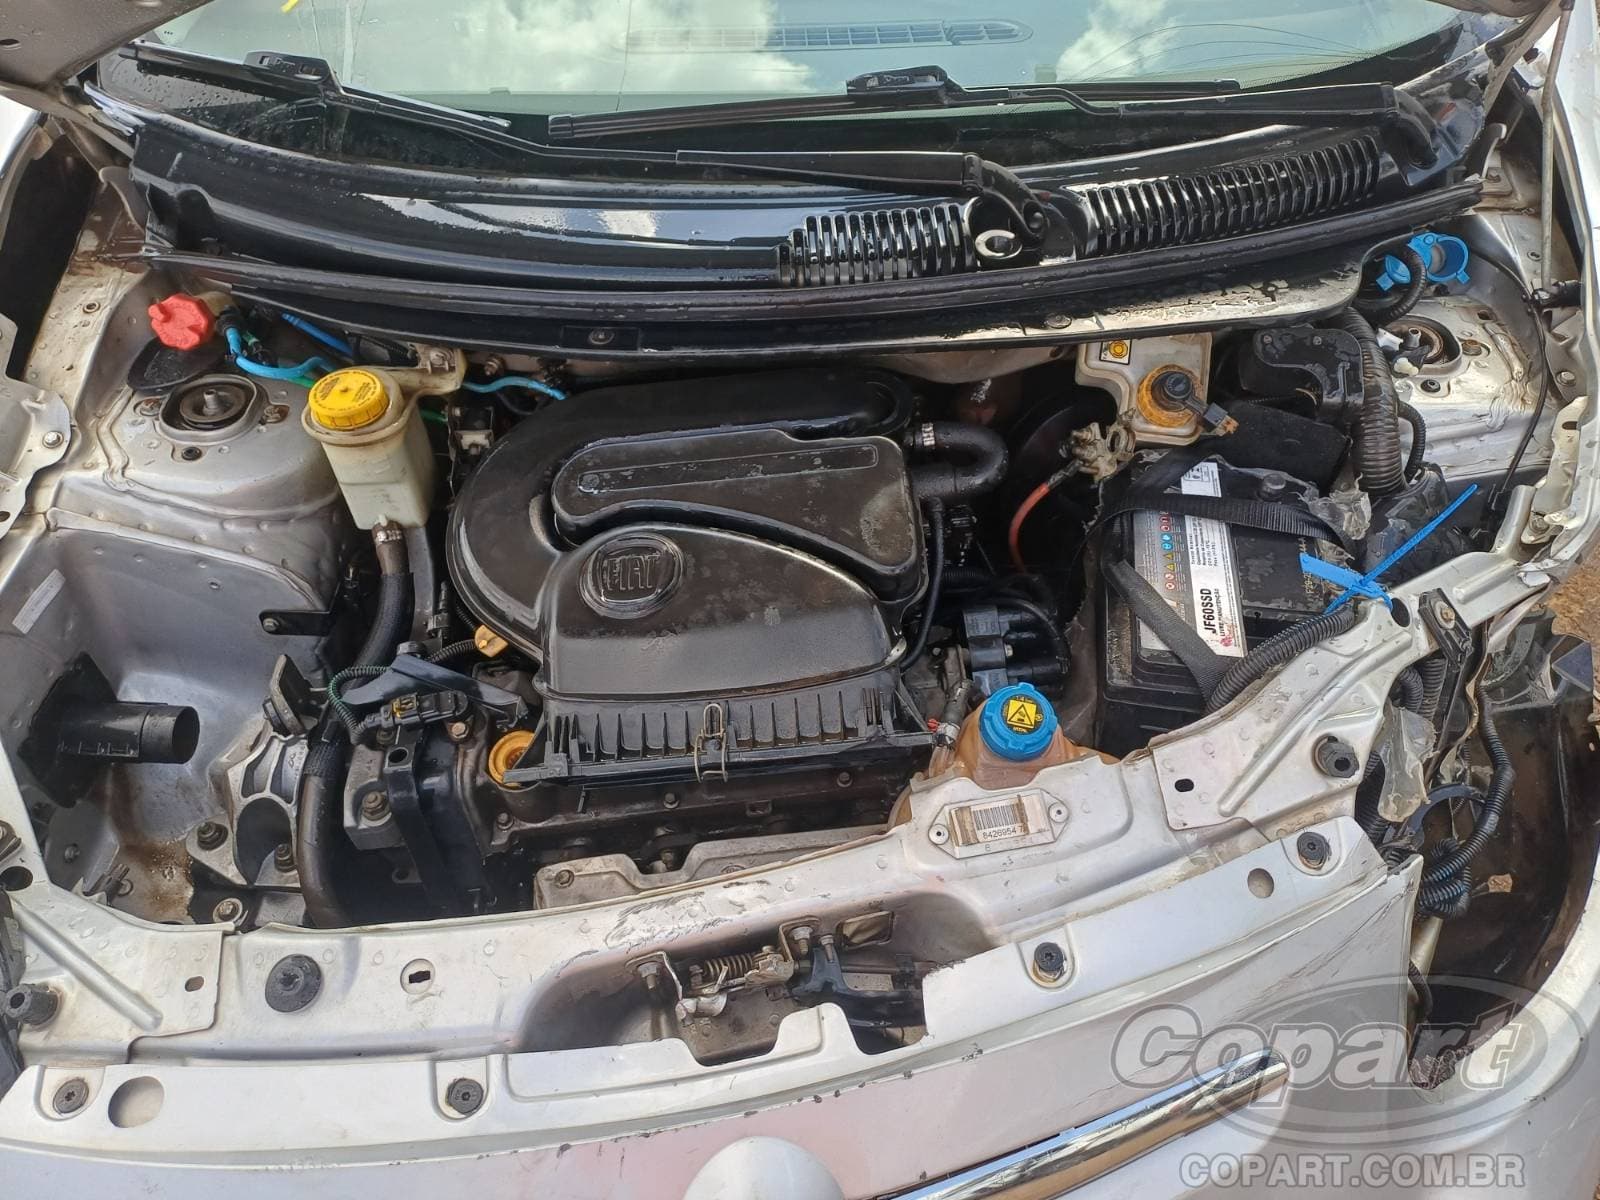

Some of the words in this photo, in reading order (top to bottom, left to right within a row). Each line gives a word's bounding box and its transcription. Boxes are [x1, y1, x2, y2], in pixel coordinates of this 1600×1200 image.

[603, 550, 661, 591] FIAT
[1199, 588, 1217, 635] JF60SSD
[1218, 622, 1226, 637] LIVRE
